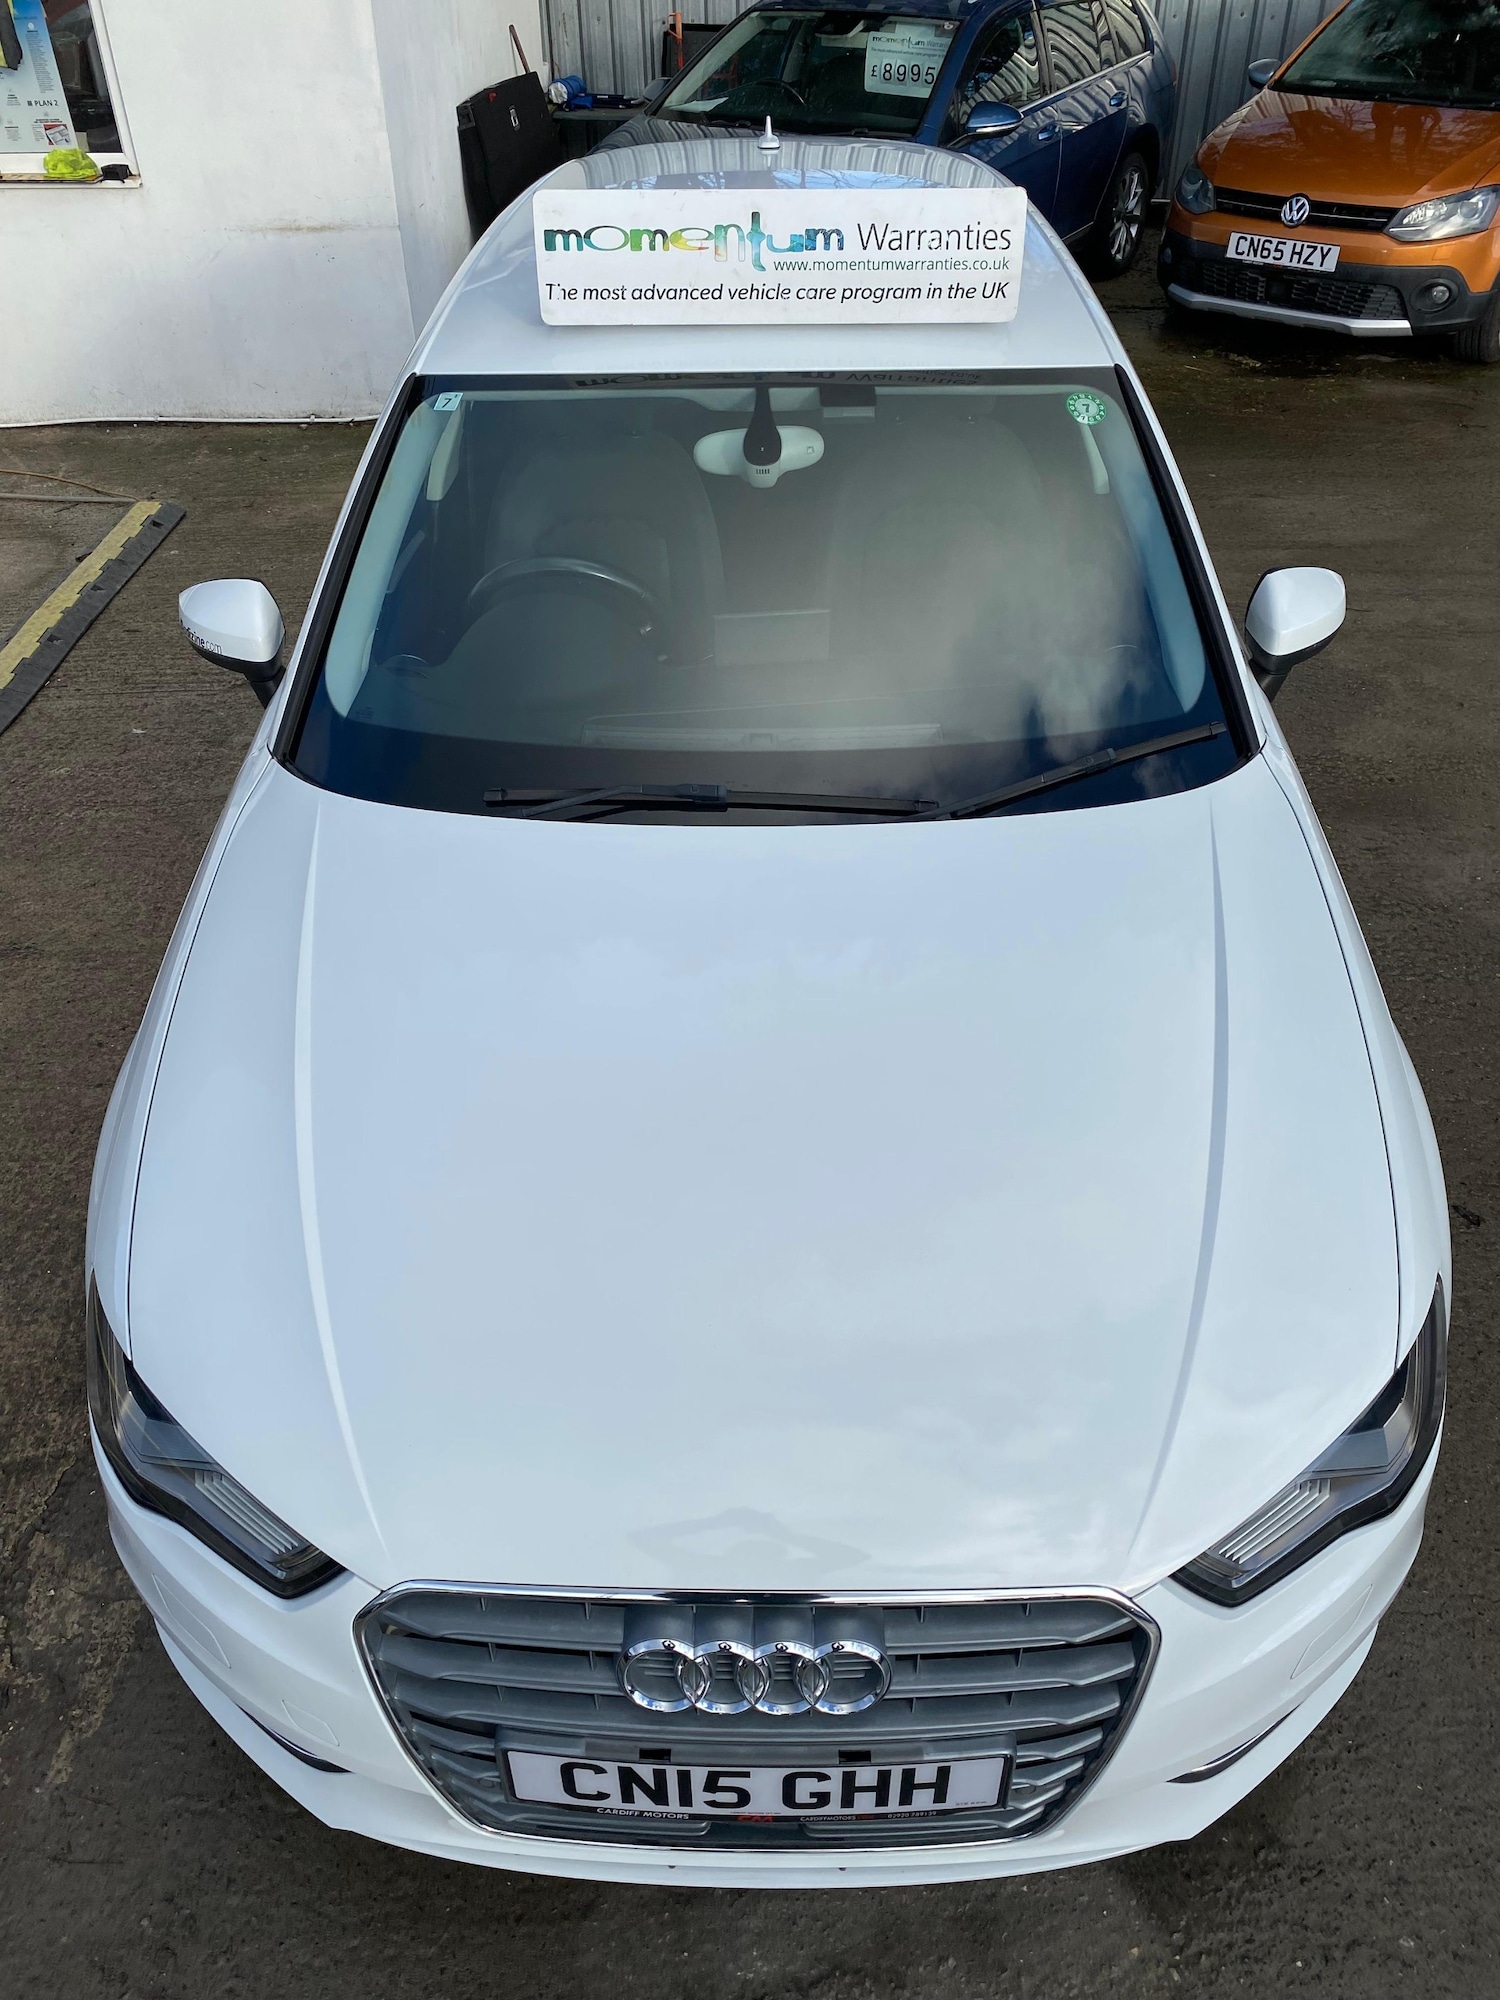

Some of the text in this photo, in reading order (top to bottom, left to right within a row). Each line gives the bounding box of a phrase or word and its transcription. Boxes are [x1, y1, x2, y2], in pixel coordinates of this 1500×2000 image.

[53, 99, 59, 107] 2
[543, 211, 1012, 272] momentum Warranties
[1235, 236, 1332, 268] CN65 HZY
[773, 256, 1011, 272] www.momentumwarranties.co.uk
[582, 284, 628, 301] most
[632, 283, 724, 301] advanced
[727, 282, 792, 301] vehicle
[795, 286, 837, 301] care
[840, 285, 922, 304] program
[925, 282, 940, 300] in
[947, 282, 977, 300] the
[981, 281, 1010, 299] UK
[1082, 403, 1090, 413] 7
[559, 1761, 952, 1810] CN15 GHH
[596, 1807, 690, 1820] CARDIFF MOTORS
